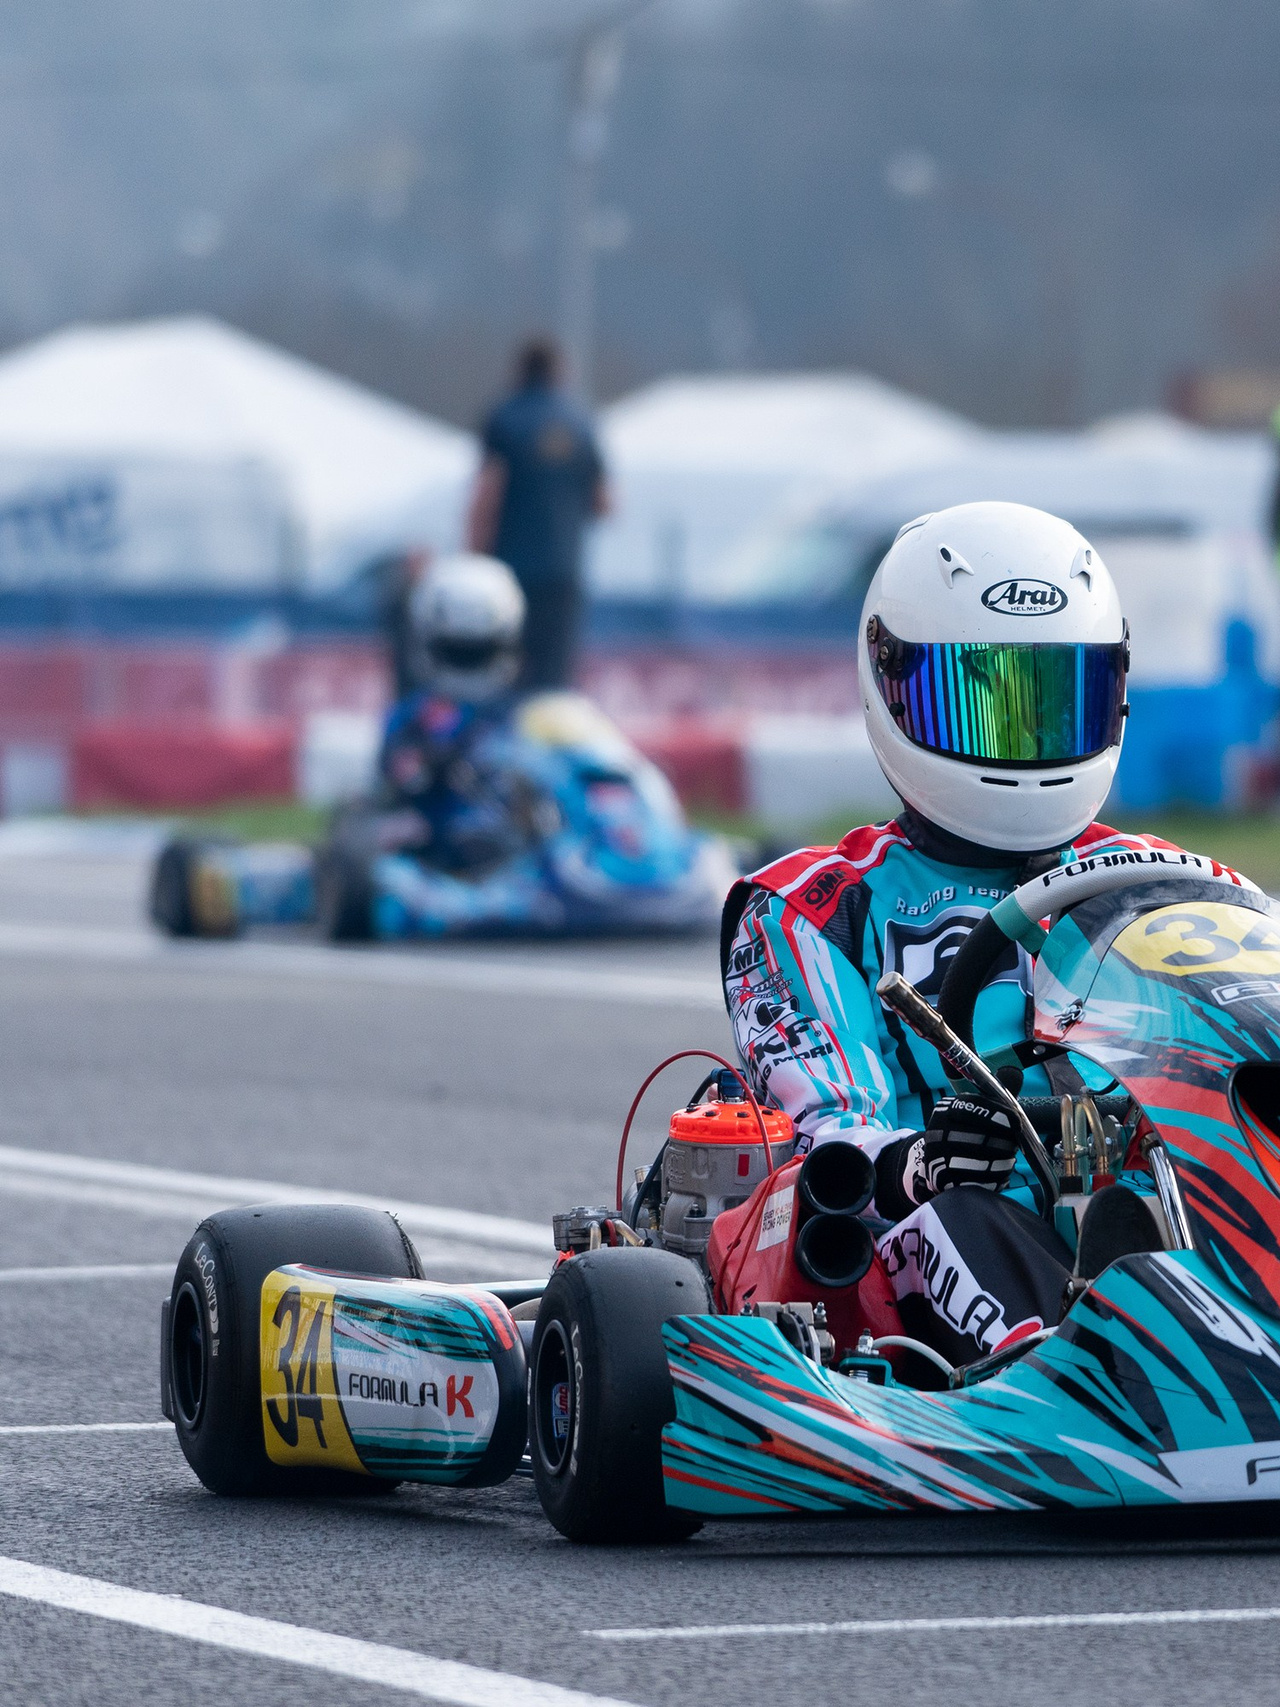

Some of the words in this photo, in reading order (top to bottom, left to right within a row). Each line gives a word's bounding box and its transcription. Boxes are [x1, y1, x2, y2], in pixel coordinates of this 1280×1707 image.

[988, 583, 1059, 606] Arai
[1042, 852, 1202, 888] FORMULA
[1210, 860, 1242, 887] K
[896, 886, 955, 916] Racing
[772, 1042, 833, 1067] MORI
[951, 1099, 990, 1117] freem
[266, 1285, 328, 1449] 34
[349, 1373, 440, 1408] FORMULA
[446, 1375, 475, 1418] K
